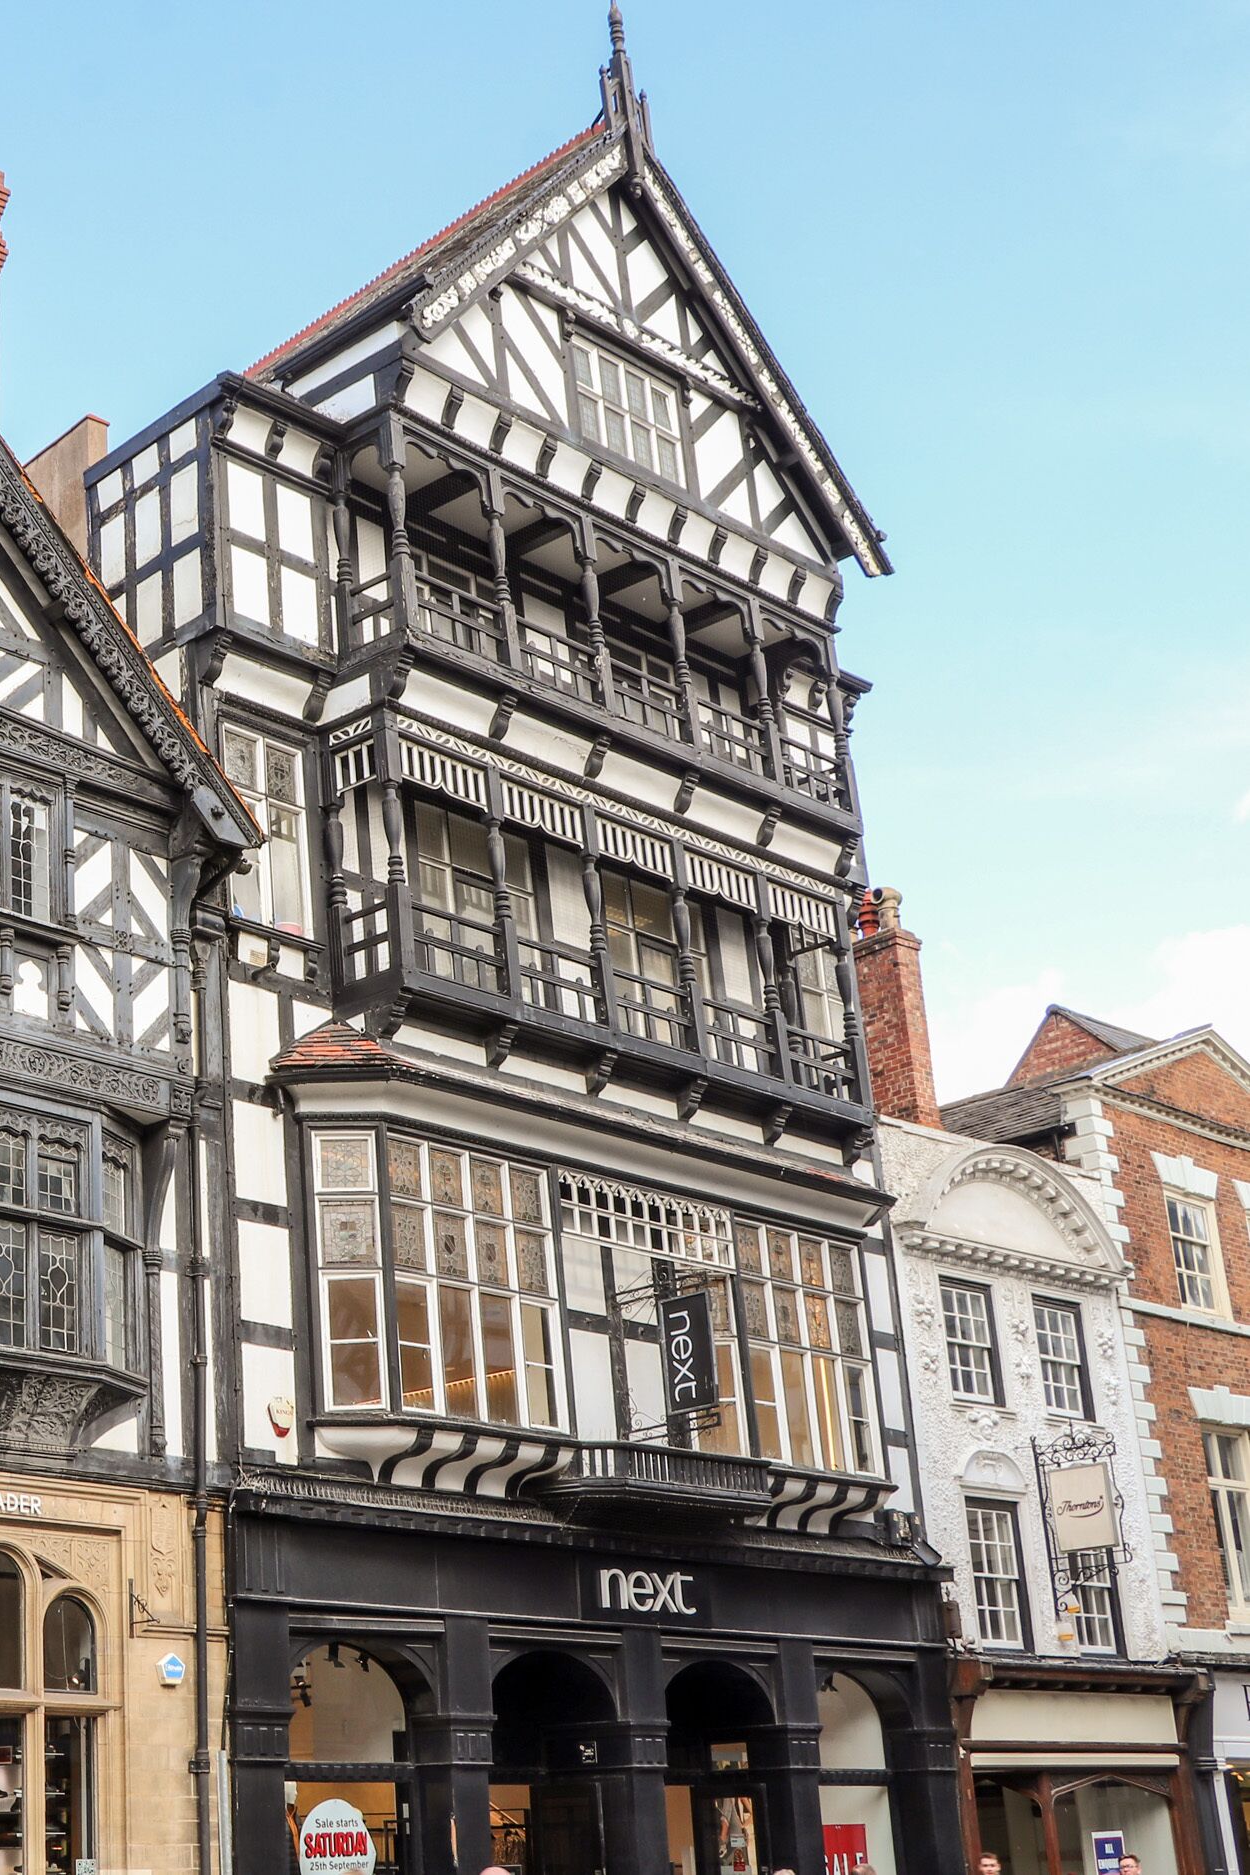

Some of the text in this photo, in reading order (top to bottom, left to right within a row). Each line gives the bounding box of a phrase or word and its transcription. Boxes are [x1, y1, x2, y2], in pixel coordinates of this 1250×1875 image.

[669, 1310, 697, 1402] next
[1057, 1500, 1102, 1516] Thorntons
[599, 1568, 697, 1615] next
[315, 1818, 359, 1829] Sale starts
[304, 1831, 368, 1859] SATURDAY
[310, 1860, 369, 1872] 25th September
